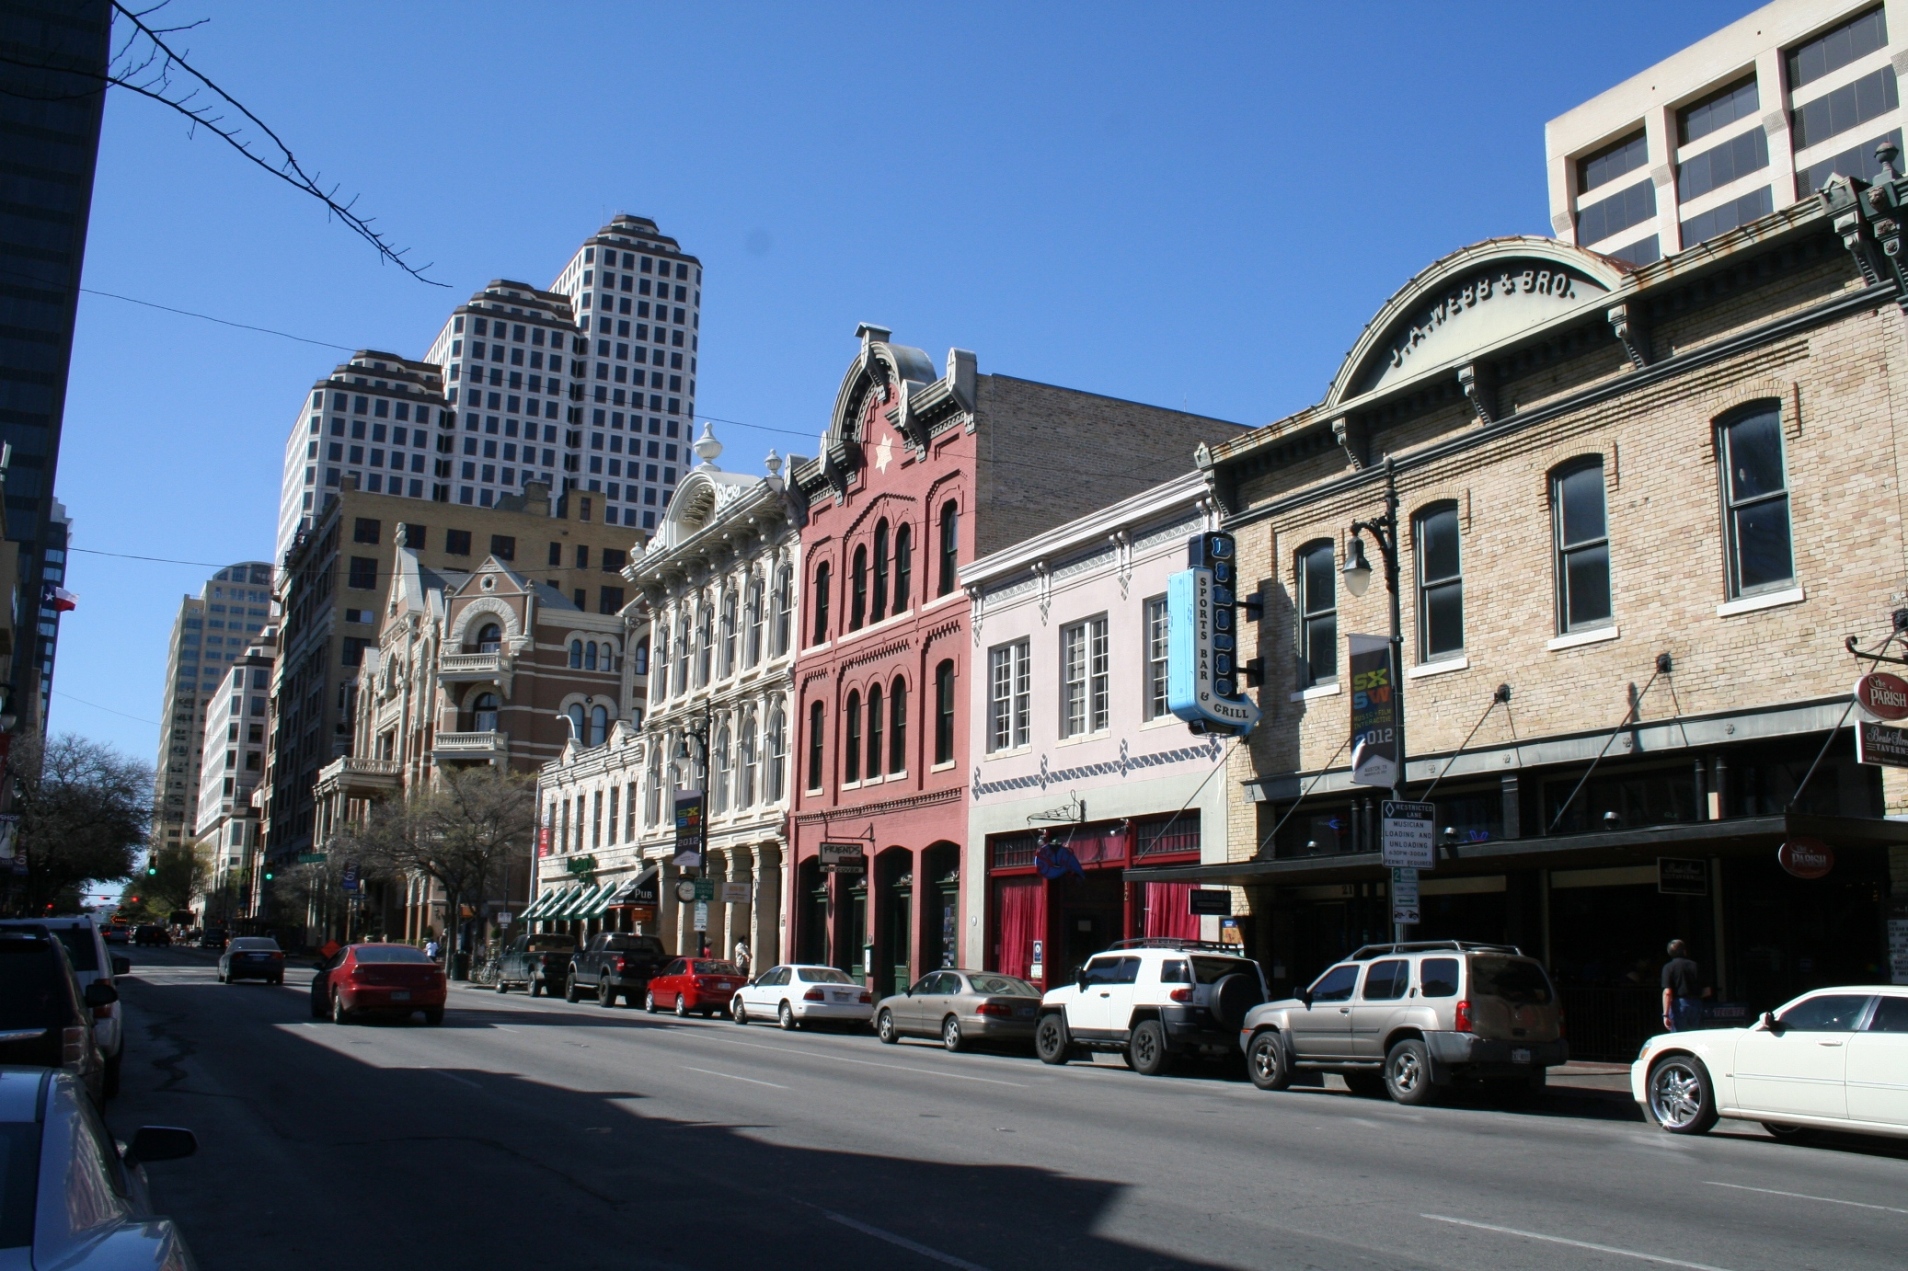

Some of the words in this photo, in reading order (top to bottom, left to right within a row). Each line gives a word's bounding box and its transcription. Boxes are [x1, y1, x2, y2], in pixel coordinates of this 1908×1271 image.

[1430, 278, 1494, 326] WEBB
[1500, 273, 1517, 299] &
[1522, 269, 1576, 300] BRO.
[1199, 576, 1208, 640] SPORTS
[1199, 648, 1209, 681] BAR
[1200, 691, 1210, 701] &
[1214, 703, 1249, 719] GRILL
[1354, 716, 1392, 730] INTERACTIVE
[1355, 728, 1393, 746] 2012
[1866, 726, 1892, 743] Beale
[1876, 743, 1906, 755] TAVERN
[1395, 803, 1433, 813] RESTRICTED
[1385, 831, 1414, 839] LOADING
[1418, 832, 1432, 840] AND
[677, 837, 699, 847] 2012
[1389, 841, 1428, 849] UNLOADING
[824, 845, 860, 855] FRIENDS
[1394, 869, 1400, 880] 2
